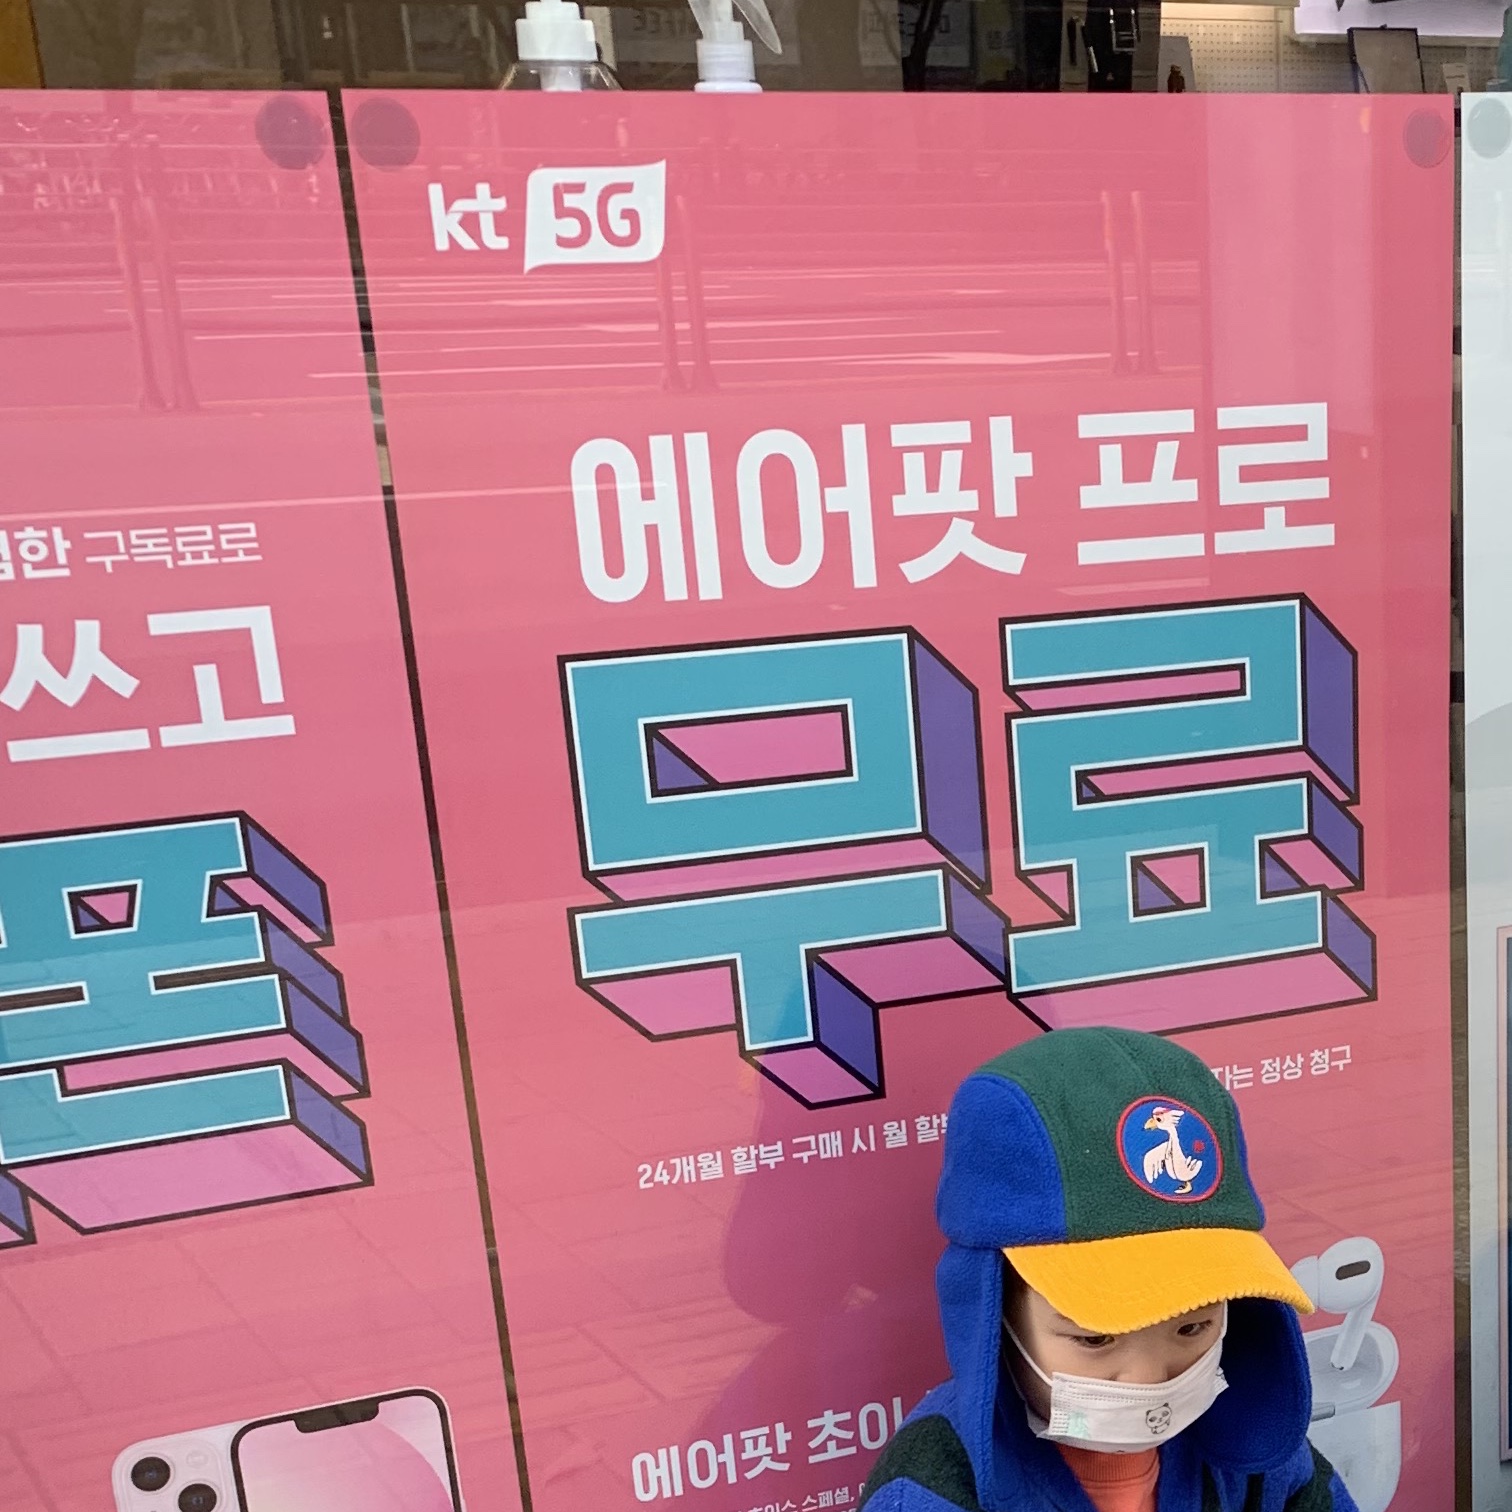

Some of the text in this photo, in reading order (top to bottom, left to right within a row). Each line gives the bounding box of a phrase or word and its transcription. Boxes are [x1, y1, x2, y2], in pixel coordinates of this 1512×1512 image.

[427, 181, 642, 251] kt 5G
[83, 522, 263, 573] 구독료로
[569, 402, 1336, 604] 에어팟 프로
[0, 605, 297, 763] 쓰고
[557, 592, 1378, 1111] 무료
[637, 1151, 724, 1189] 24개월
[730, 1141, 785, 1176] 할부
[792, 1130, 844, 1165] 구매
[851, 1125, 877, 1154] 시
[882, 1120, 908, 1149] 월
[1260, 1053, 1305, 1085] 정상
[1309, 1044, 1352, 1076] 청구
[631, 1421, 793, 1503] 에어팟
